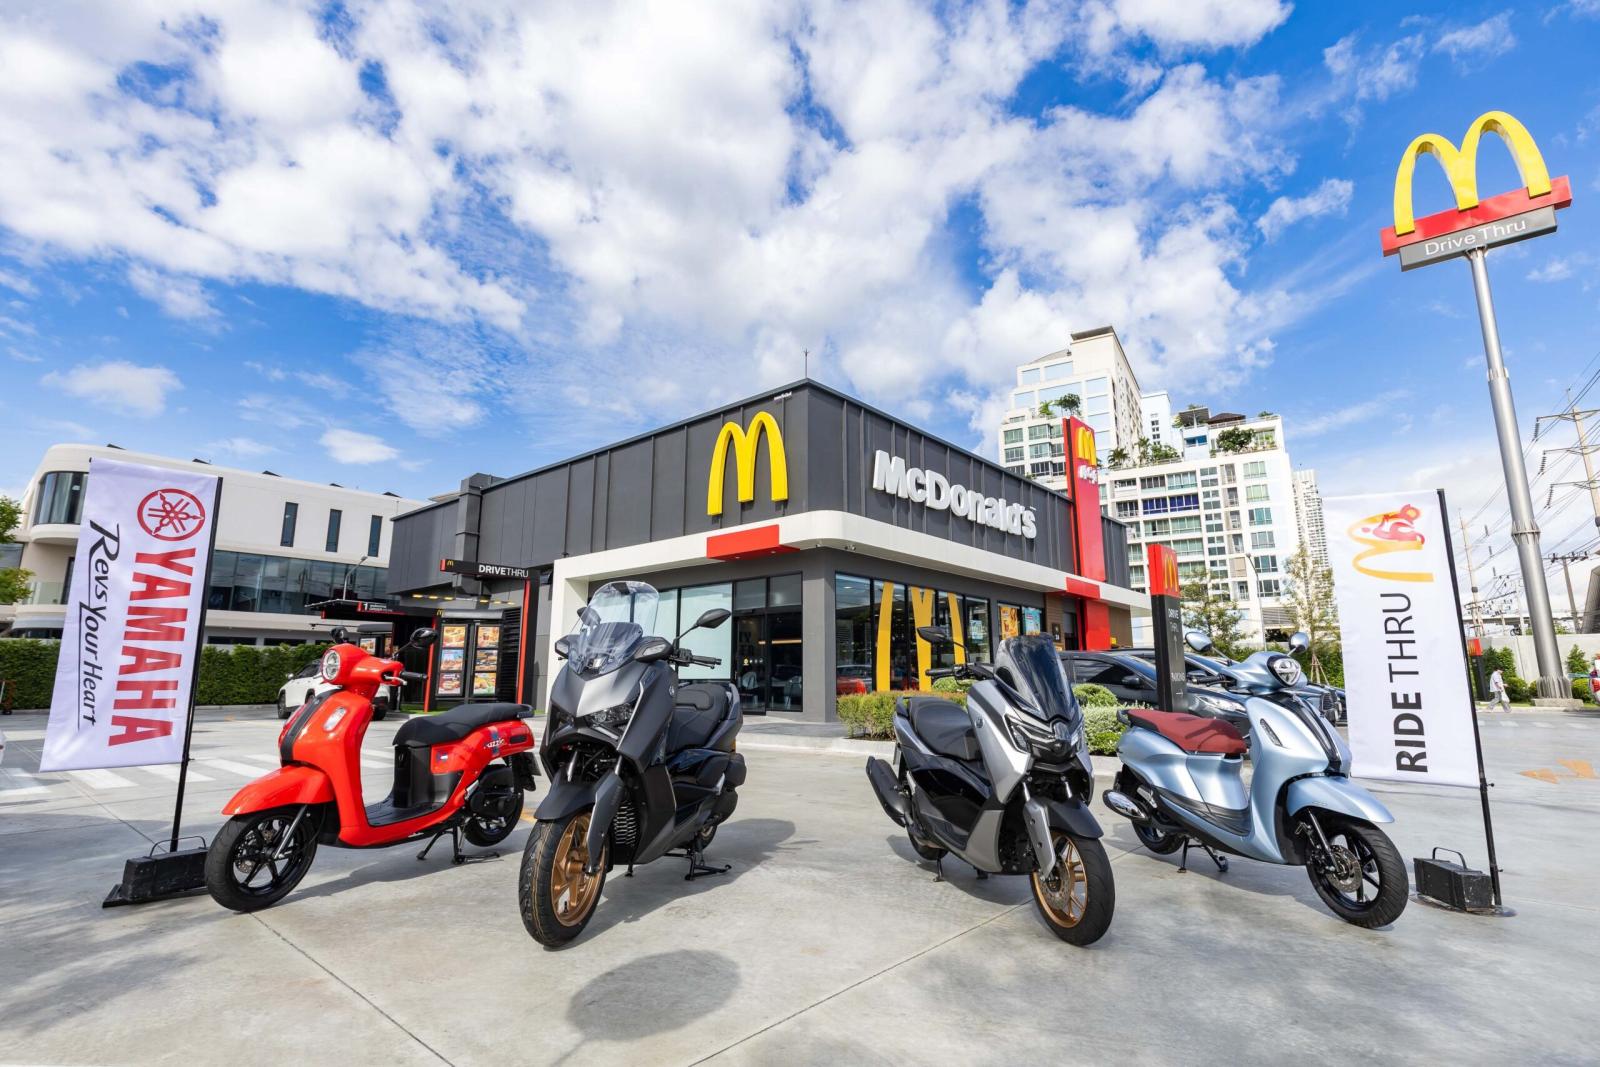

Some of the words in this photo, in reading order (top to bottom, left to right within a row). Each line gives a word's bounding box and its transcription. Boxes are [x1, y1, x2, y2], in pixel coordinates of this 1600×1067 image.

[1424, 232, 1476, 256] Drive
[1479, 219, 1527, 241] Thru
[872, 449, 1037, 539] McDonald's
[89, 519, 121, 602] Revs
[79, 600, 107, 661] Your
[108, 547, 197, 747] YAMAHA
[1168, 608, 1179, 620] DRIVE
[1380, 592, 1420, 683] THRU
[81, 662, 103, 727] Heart
[1391, 692, 1428, 773] RIDE
